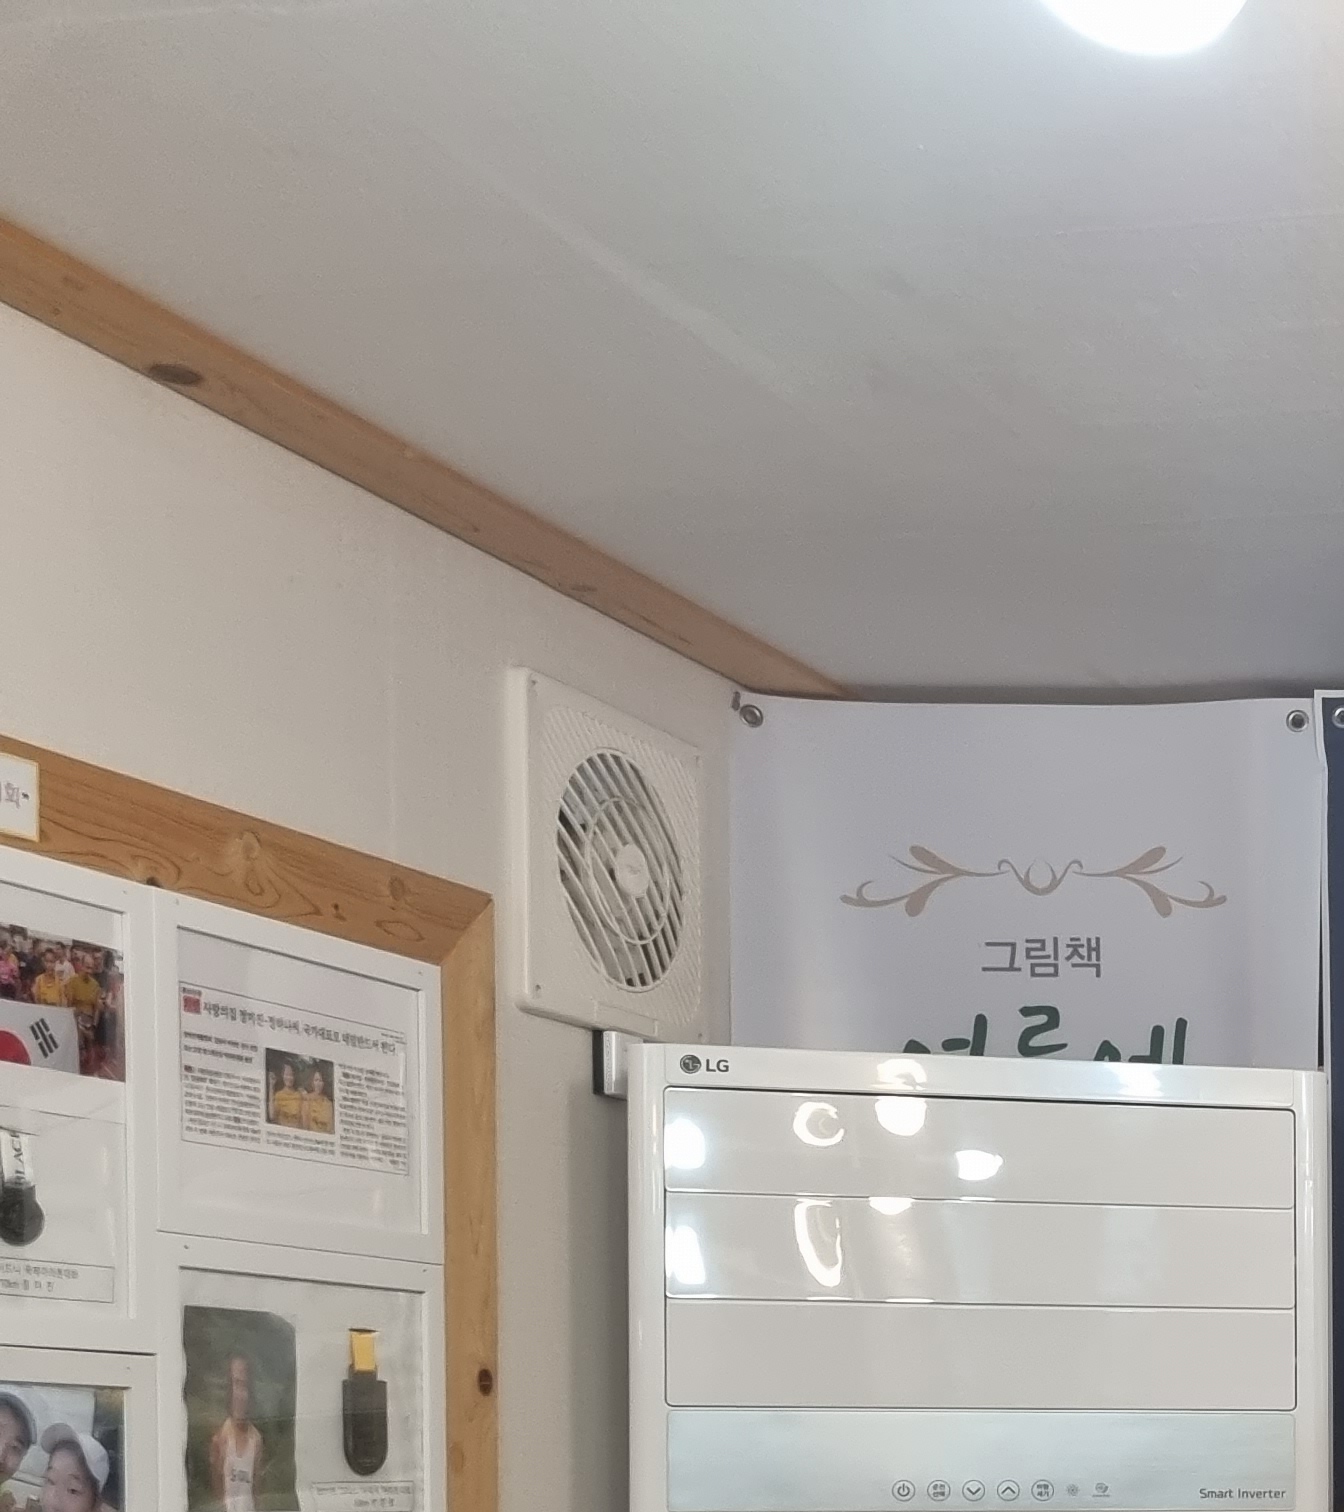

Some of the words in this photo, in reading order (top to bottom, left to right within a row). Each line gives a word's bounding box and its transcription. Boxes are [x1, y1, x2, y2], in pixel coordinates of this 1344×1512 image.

[981, 937, 1103, 978] 그림책
[705, 1058, 730, 1073] LG
[1199, 1488, 1233, 1499] Smart
[1237, 1488, 1287, 1499] Inverter
